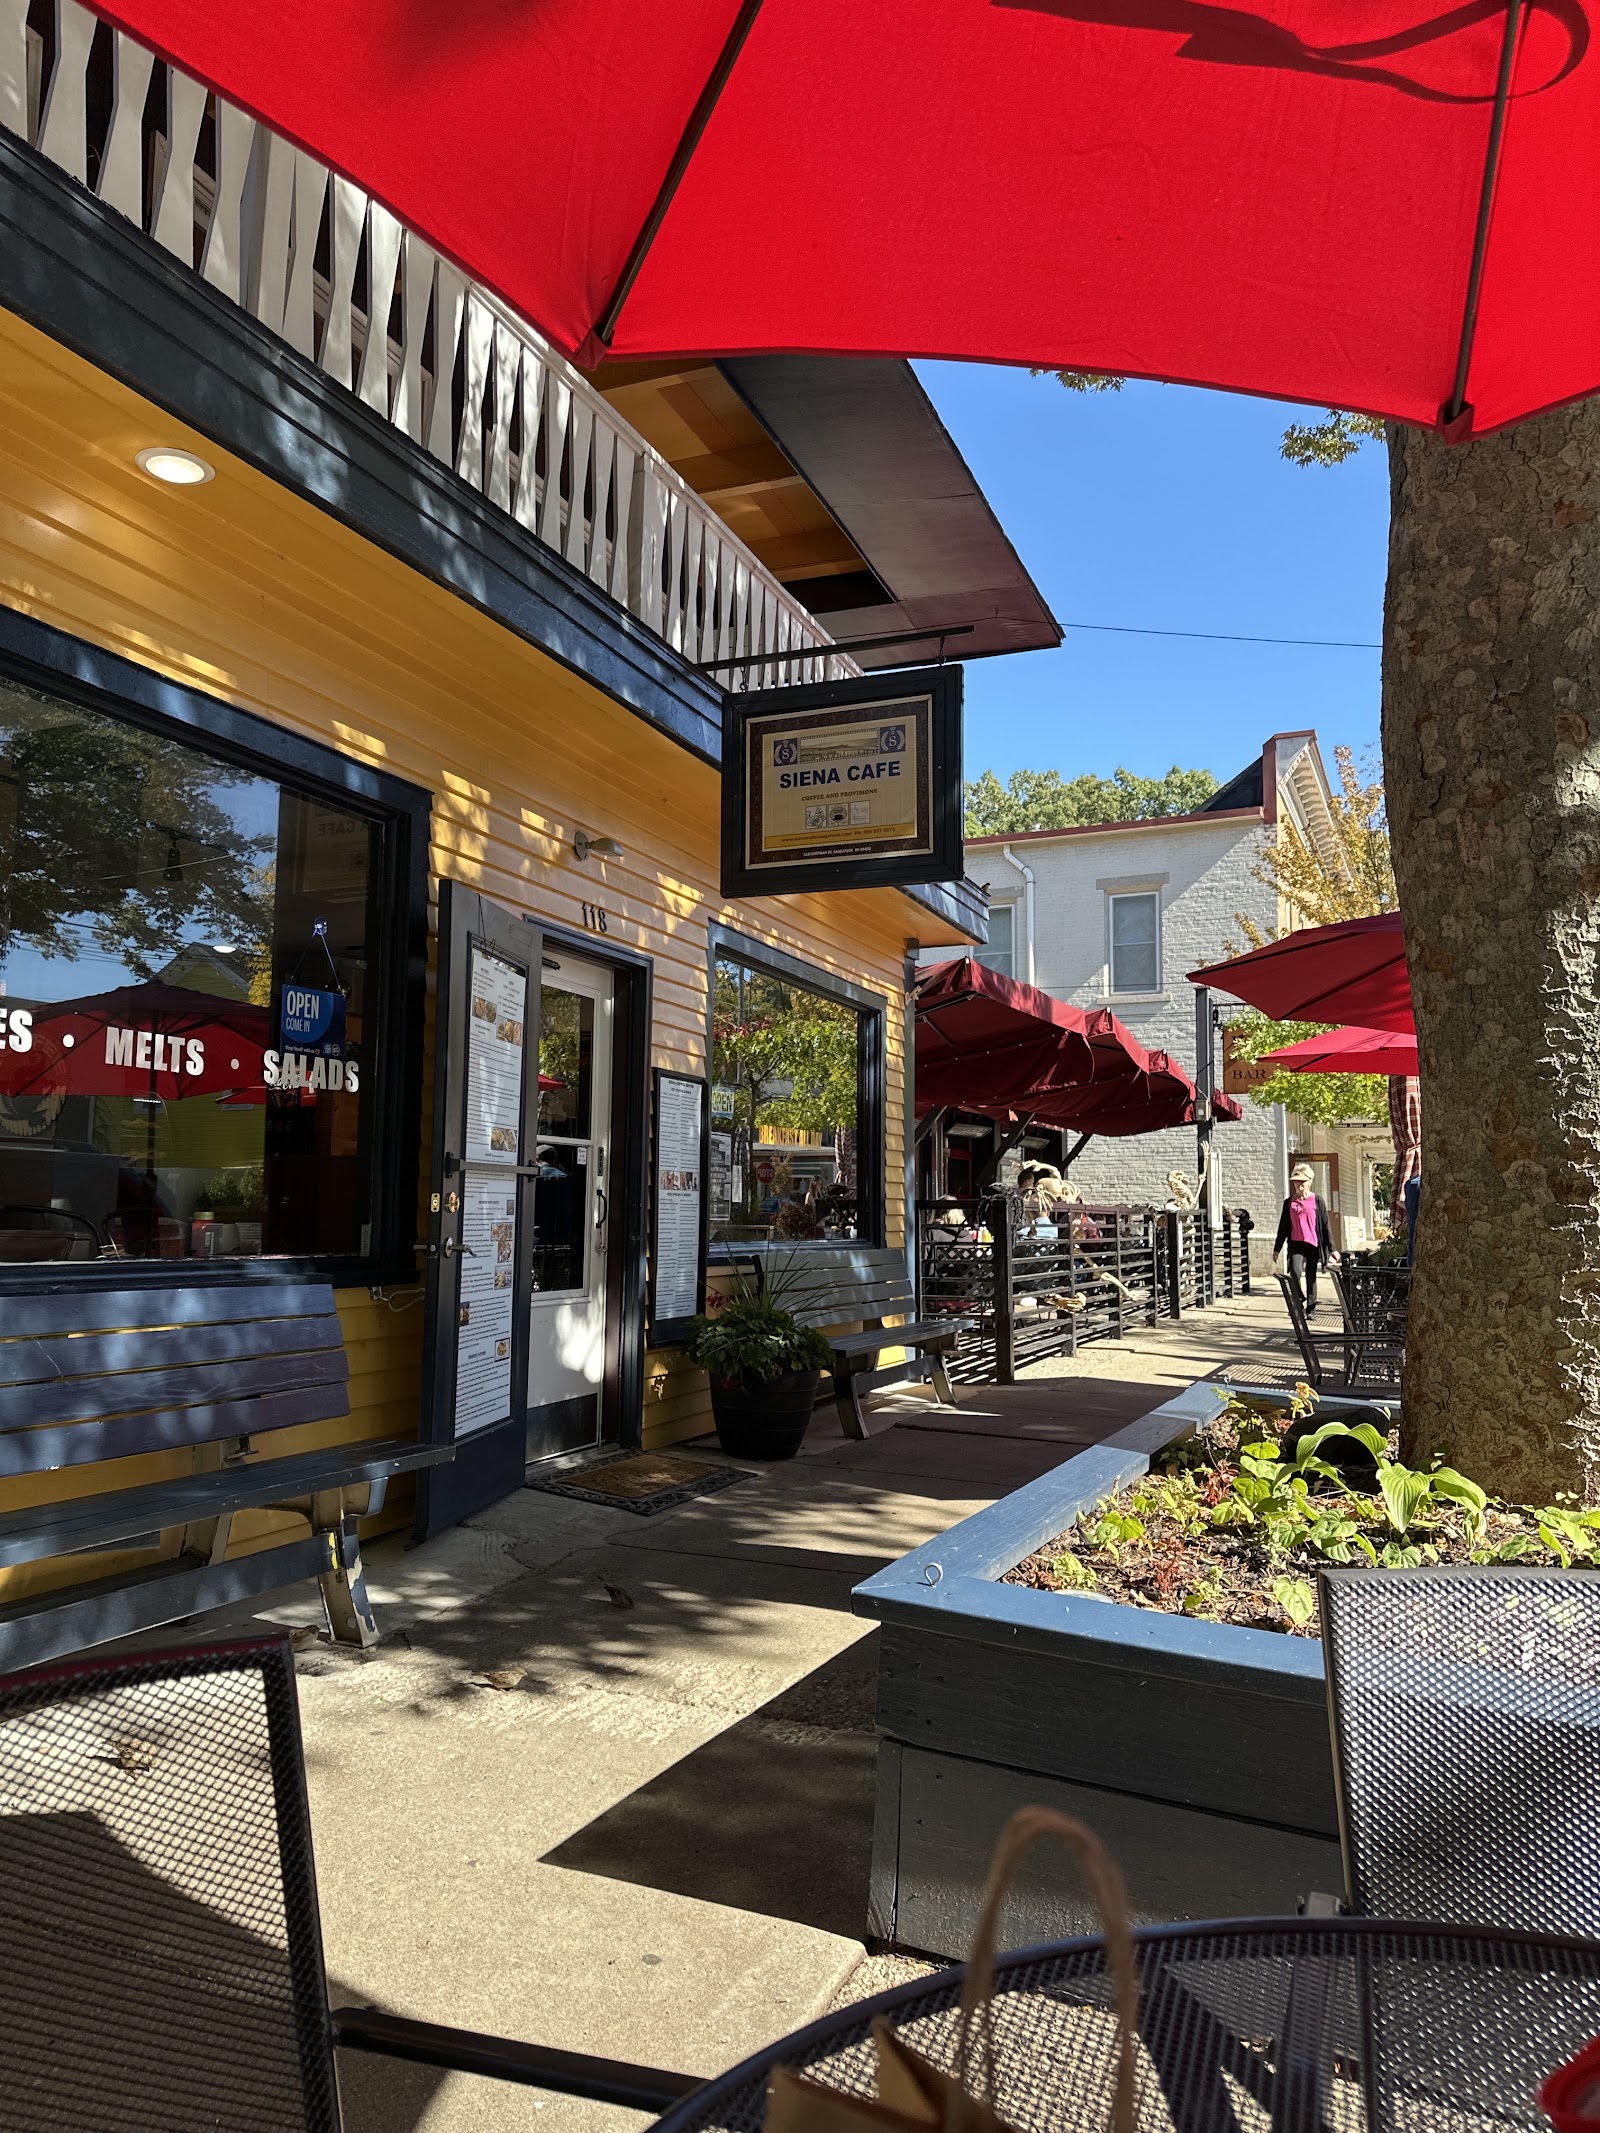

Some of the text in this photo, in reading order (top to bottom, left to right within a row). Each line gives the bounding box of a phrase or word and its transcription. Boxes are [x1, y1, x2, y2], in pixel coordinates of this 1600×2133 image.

[779, 760, 901, 789] SIENA CAFE
[801, 788, 878, 802] COFFEE AND PROVISIONS
[581, 902, 608, 933] 118
[286, 990, 320, 1019] OPEN
[285, 1017, 311, 1033] COME IN
[104, 1026, 205, 1076] MELTS
[263, 1049, 360, 1093] SALADS
[1232, 1069, 1266, 1079] BAR
